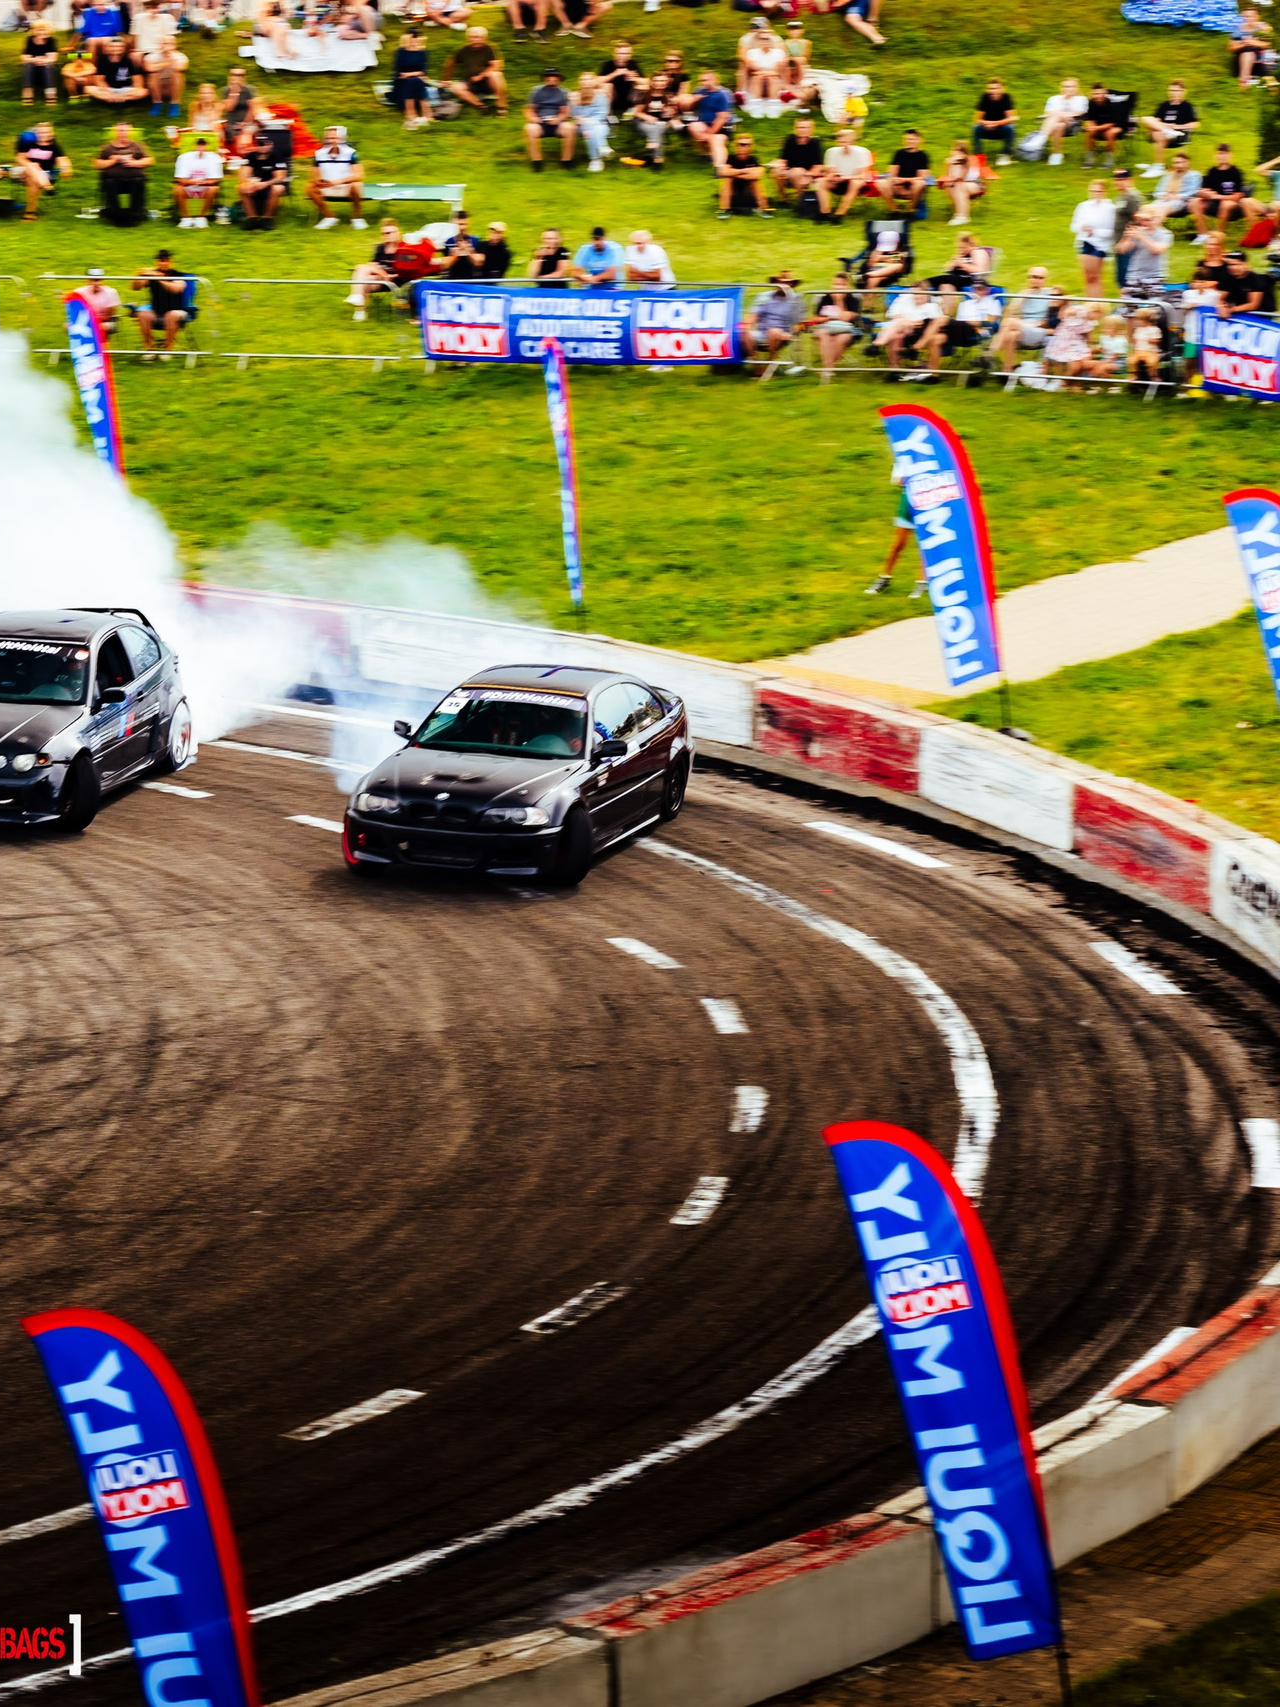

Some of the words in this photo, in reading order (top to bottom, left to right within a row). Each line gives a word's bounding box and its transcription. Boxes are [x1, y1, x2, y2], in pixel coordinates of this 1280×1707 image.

[426, 293, 505, 324] LIQUI
[510, 297, 581, 315] MOTOR
[582, 299, 632, 317] OILS
[637, 300, 727, 329] LIQUI
[427, 325, 506, 353] MOLY
[515, 318, 623, 339] ADDITIVES
[1203, 317, 1280, 357] LIQUI
[637, 331, 729, 358] MOLY
[1202, 350, 1279, 390] MOLY
